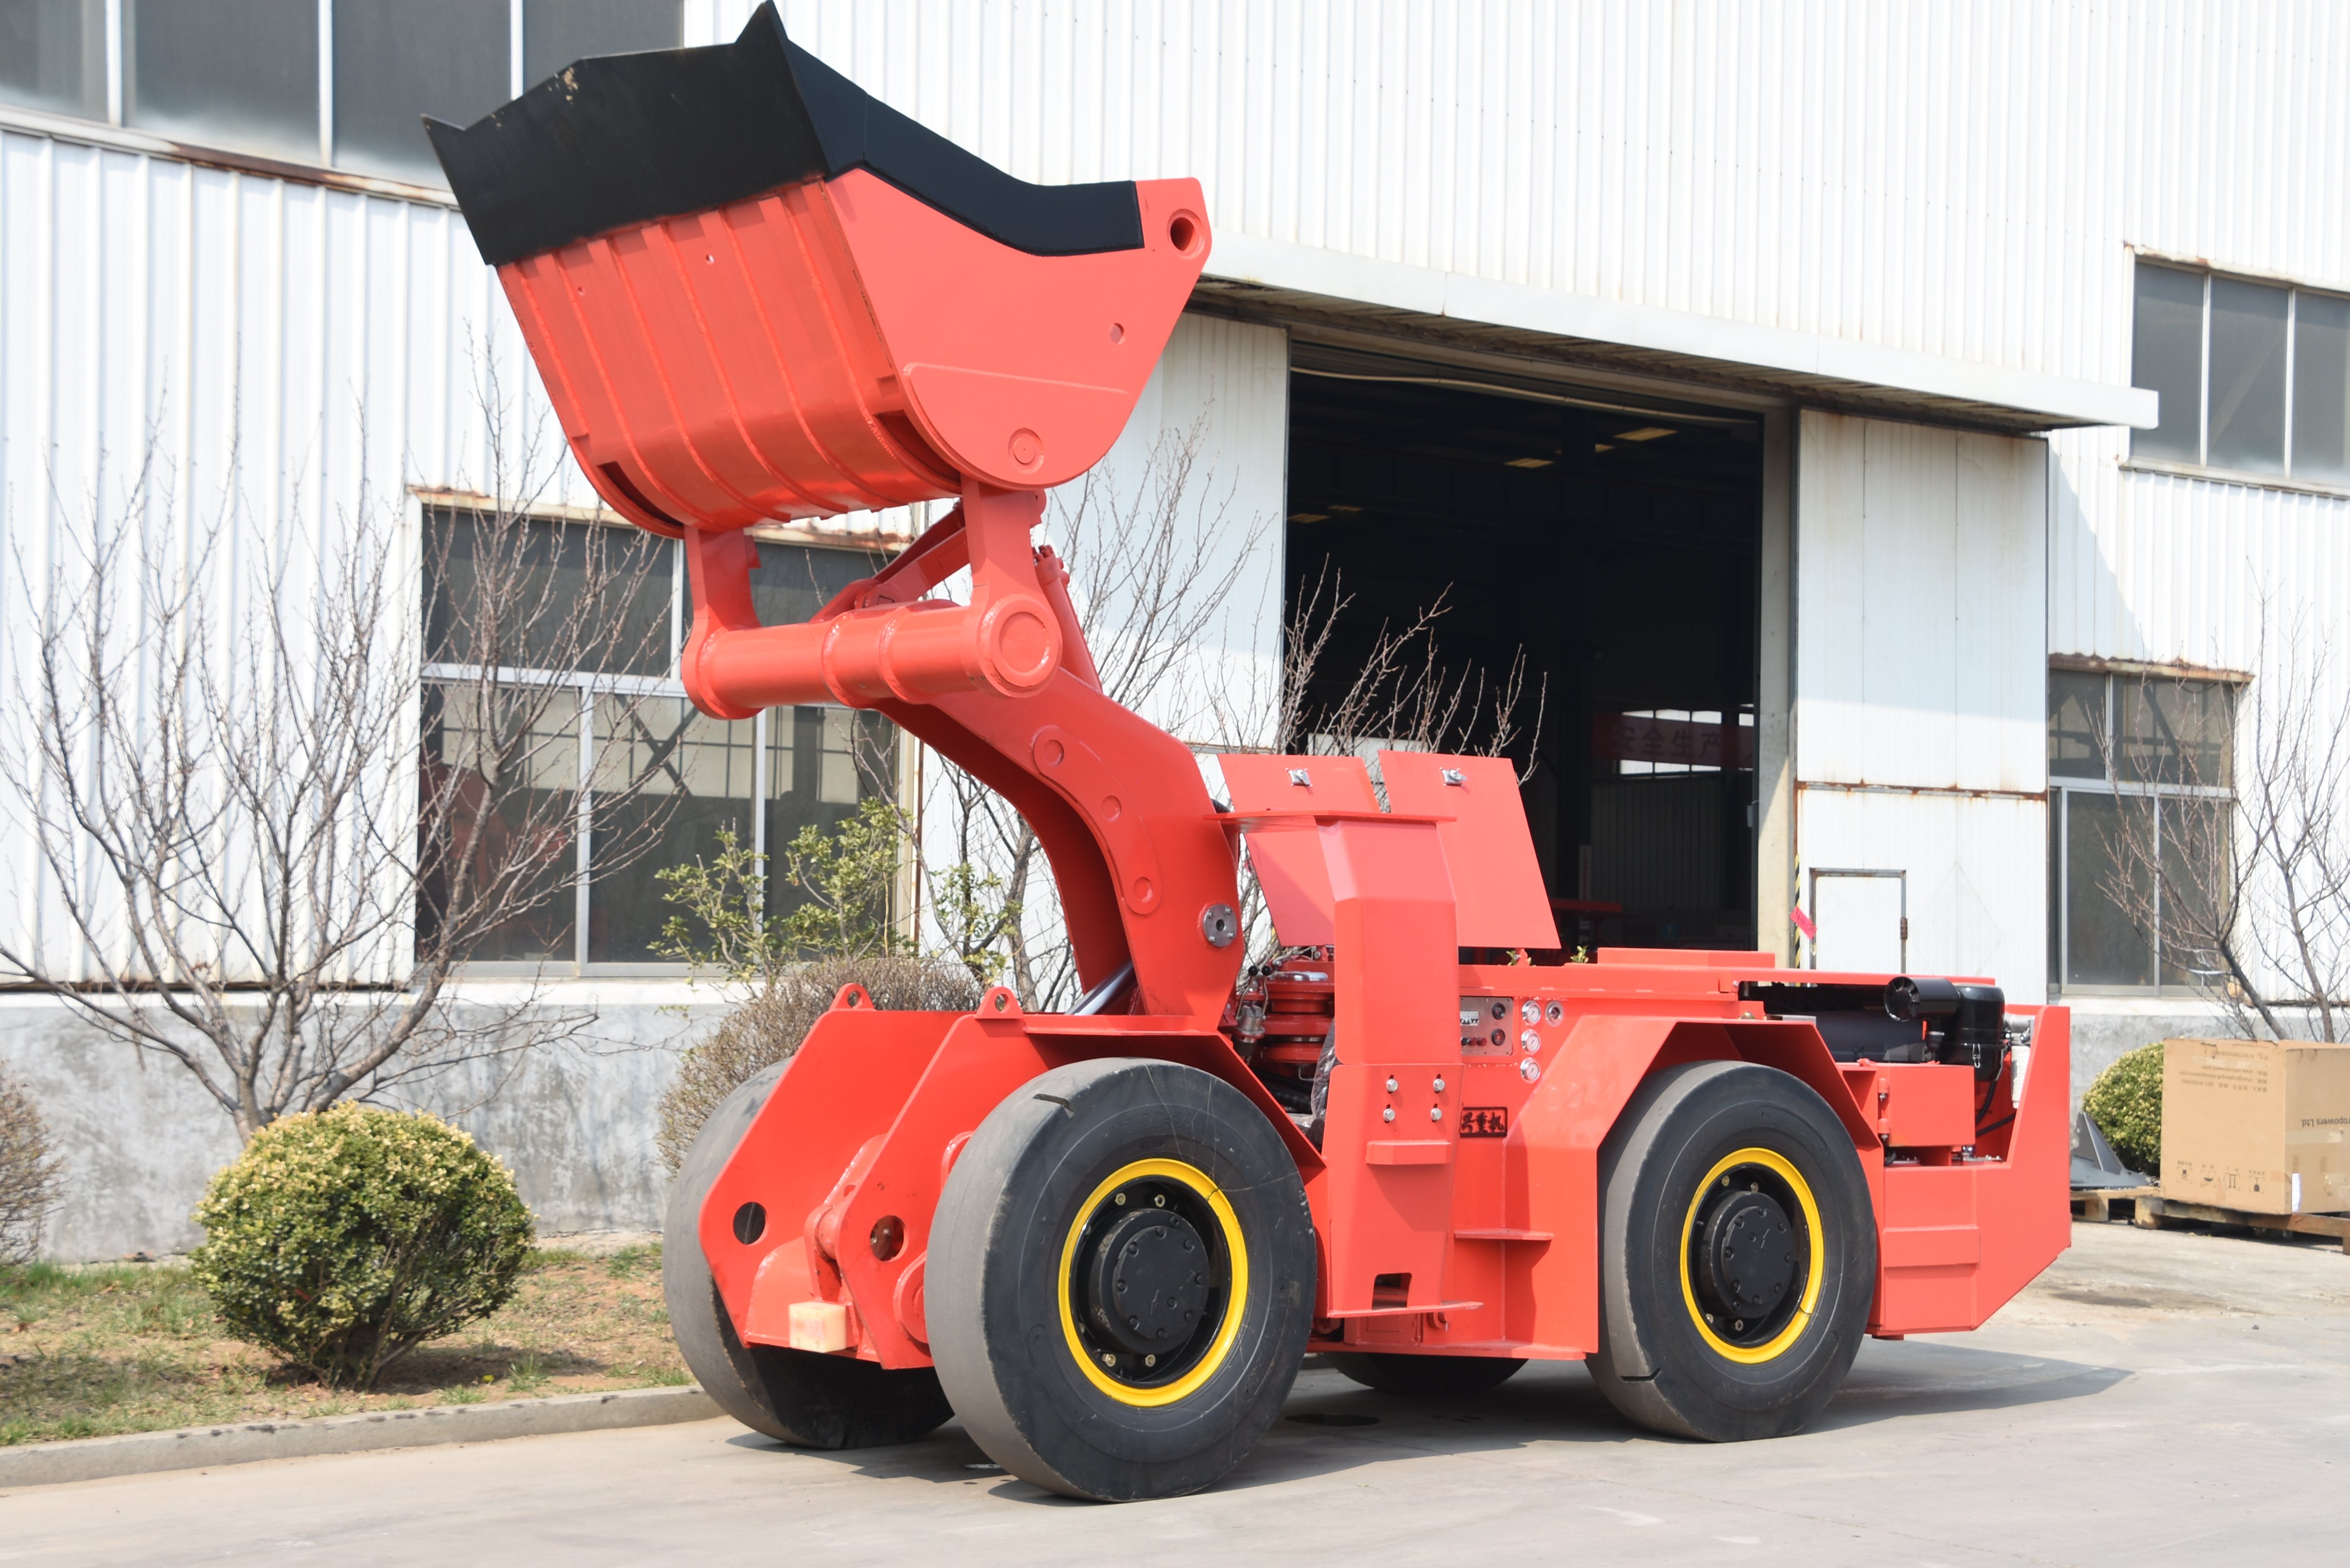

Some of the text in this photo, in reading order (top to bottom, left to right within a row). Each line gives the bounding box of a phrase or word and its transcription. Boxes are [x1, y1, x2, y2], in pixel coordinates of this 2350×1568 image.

[1613, 724, 1723, 759] 安全生产
[2300, 1119, 2314, 1127] Ltd.
